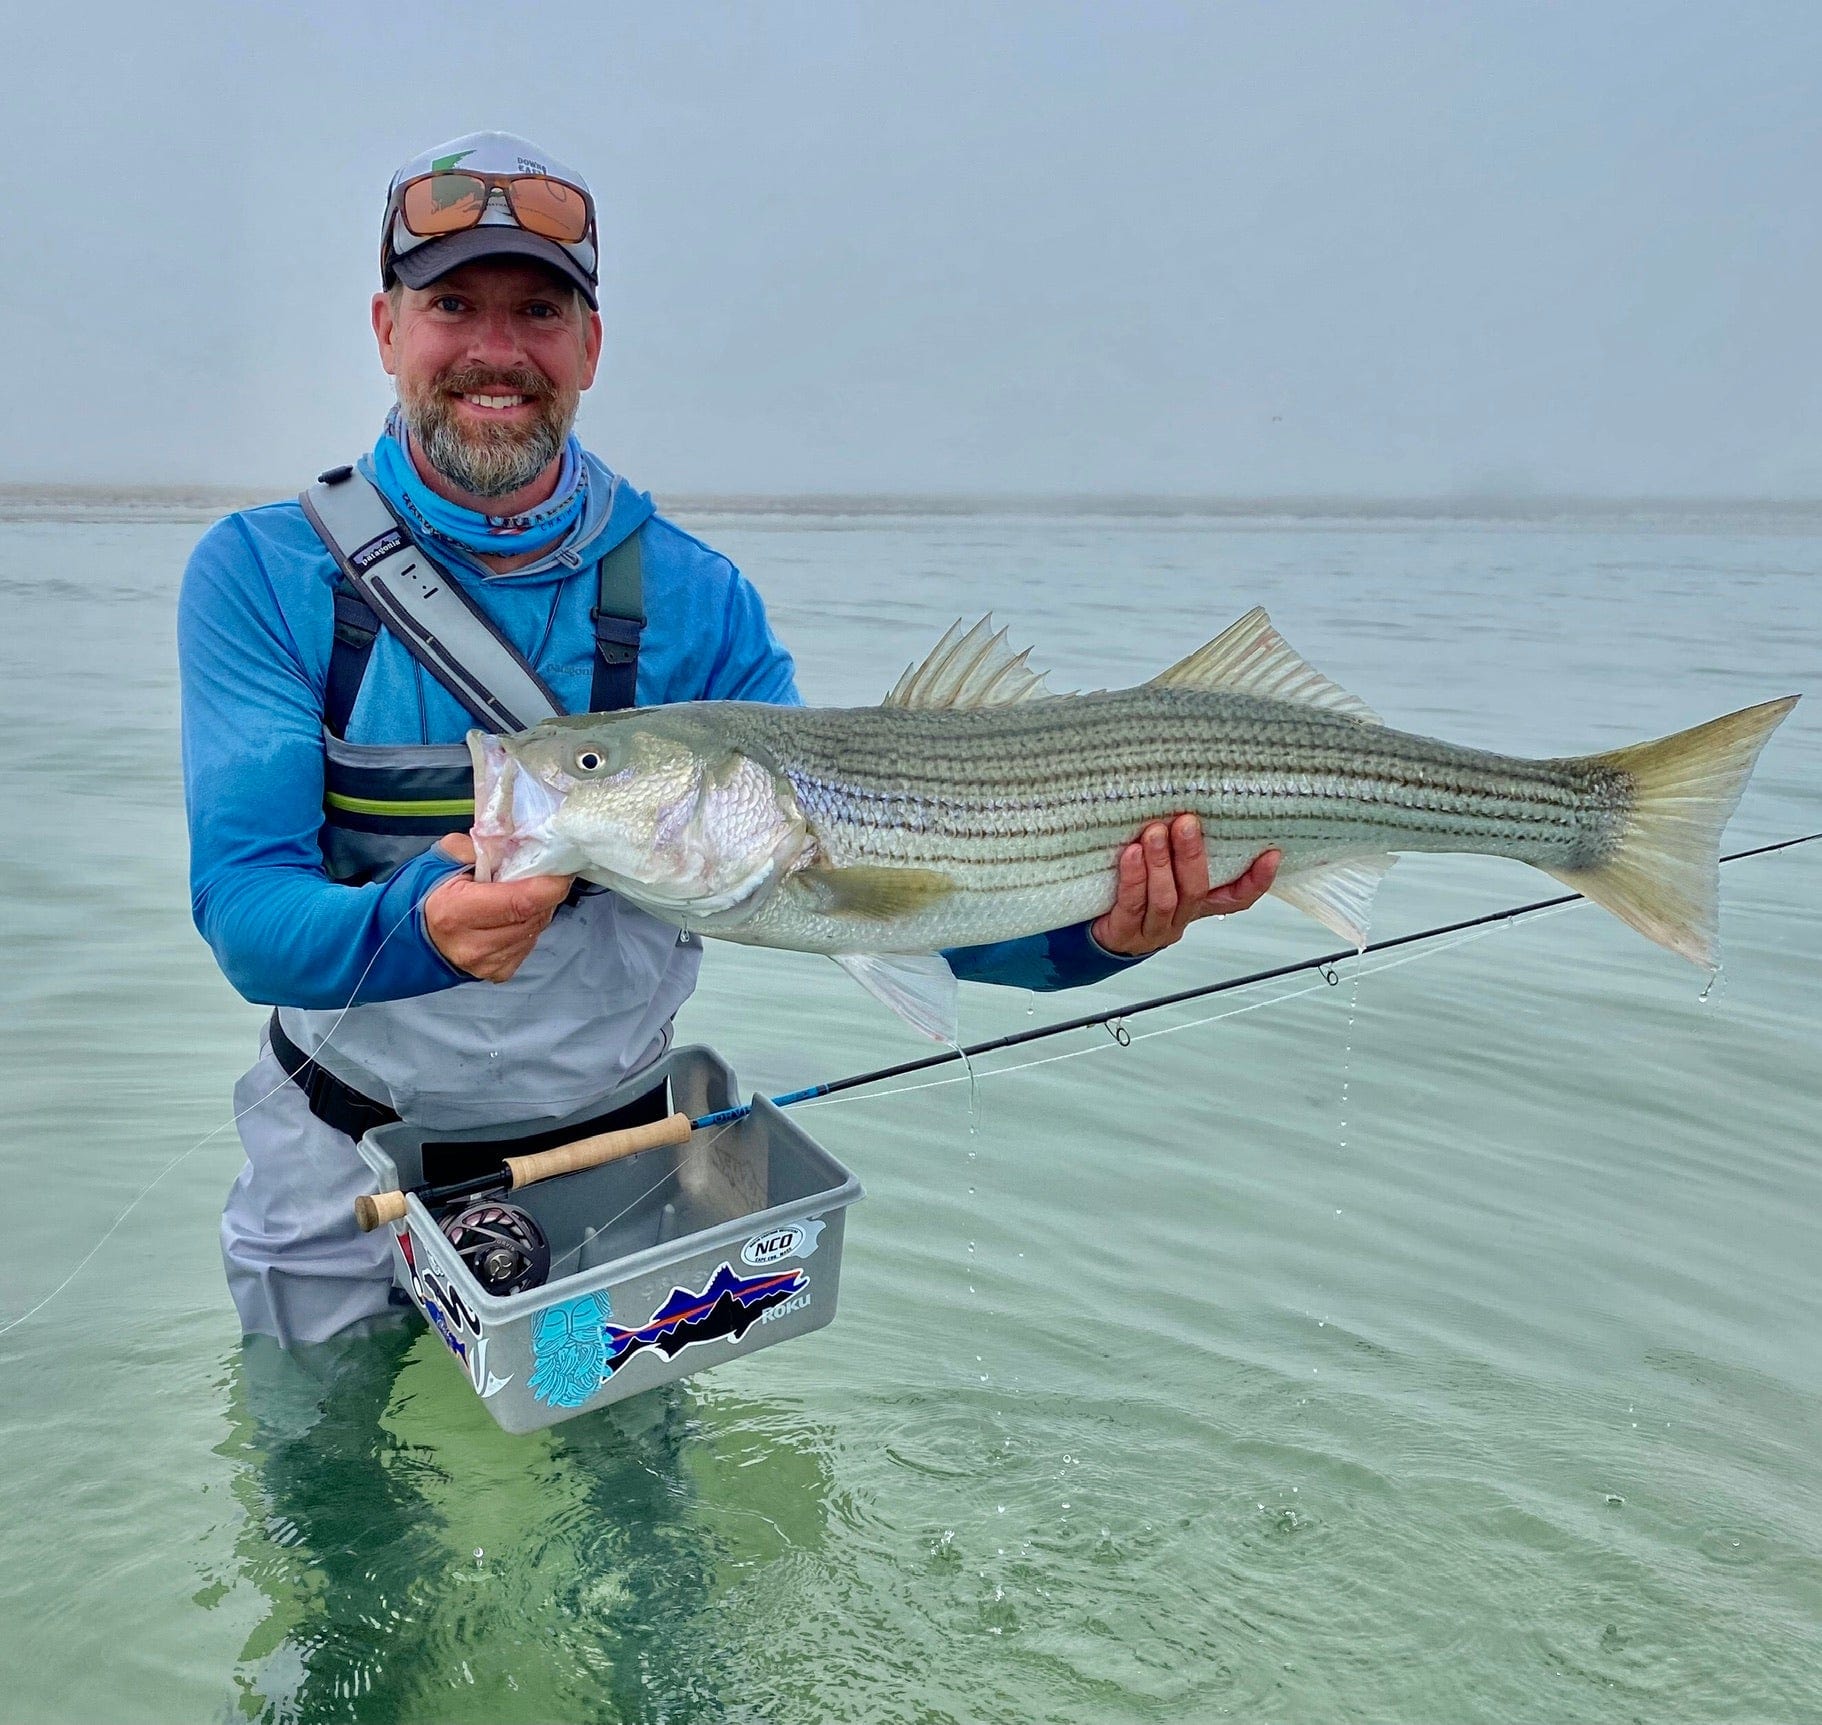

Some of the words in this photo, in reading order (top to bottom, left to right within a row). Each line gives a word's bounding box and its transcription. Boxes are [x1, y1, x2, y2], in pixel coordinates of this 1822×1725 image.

[517, 157, 542, 170] DOWN
[361, 538, 402, 566] patagonia
[496, 1240, 515, 1252] ORVIS
[754, 1233, 794, 1257] NCO
